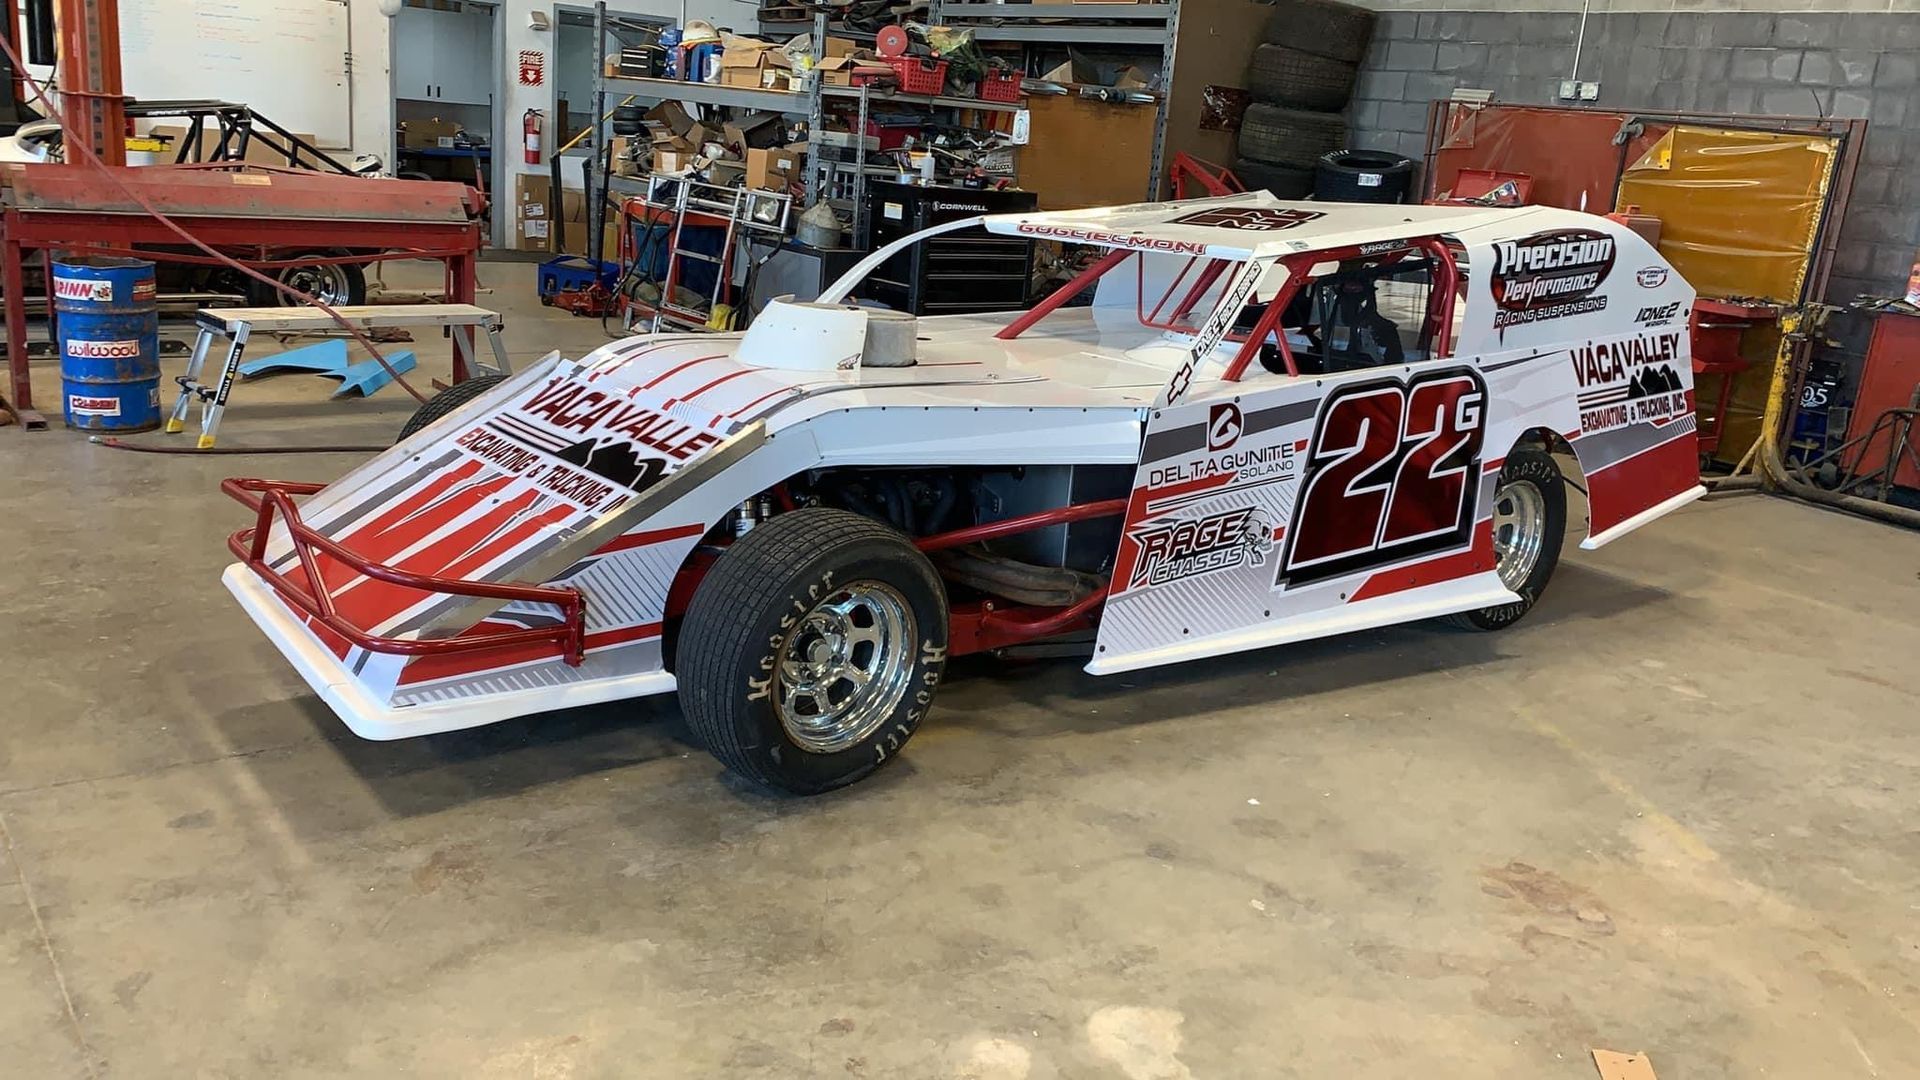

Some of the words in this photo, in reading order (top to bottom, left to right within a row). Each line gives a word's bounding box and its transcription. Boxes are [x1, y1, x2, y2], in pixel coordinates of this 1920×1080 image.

[940, 203, 988, 212] CORNWELL
[1498, 238, 1612, 275] Precision
[1502, 272, 1599, 308] Performance
[1494, 309, 1536, 328] RACING
[1536, 297, 1607, 320] SUSPENSIONS
[1570, 342, 1625, 387] VACA
[1620, 333, 1679, 367] VALLEY
[521, 377, 624, 434] VACA
[1581, 404, 1628, 432] EXCAVATING
[455, 427, 541, 473] EXCAVATING
[1150, 458, 1218, 486] DELTA
[1220, 443, 1294, 472] GUNITE
[1239, 460, 1294, 480] SOLANO
[1133, 508, 1250, 584] RAGE
[1151, 546, 1244, 582] CHASSIS
